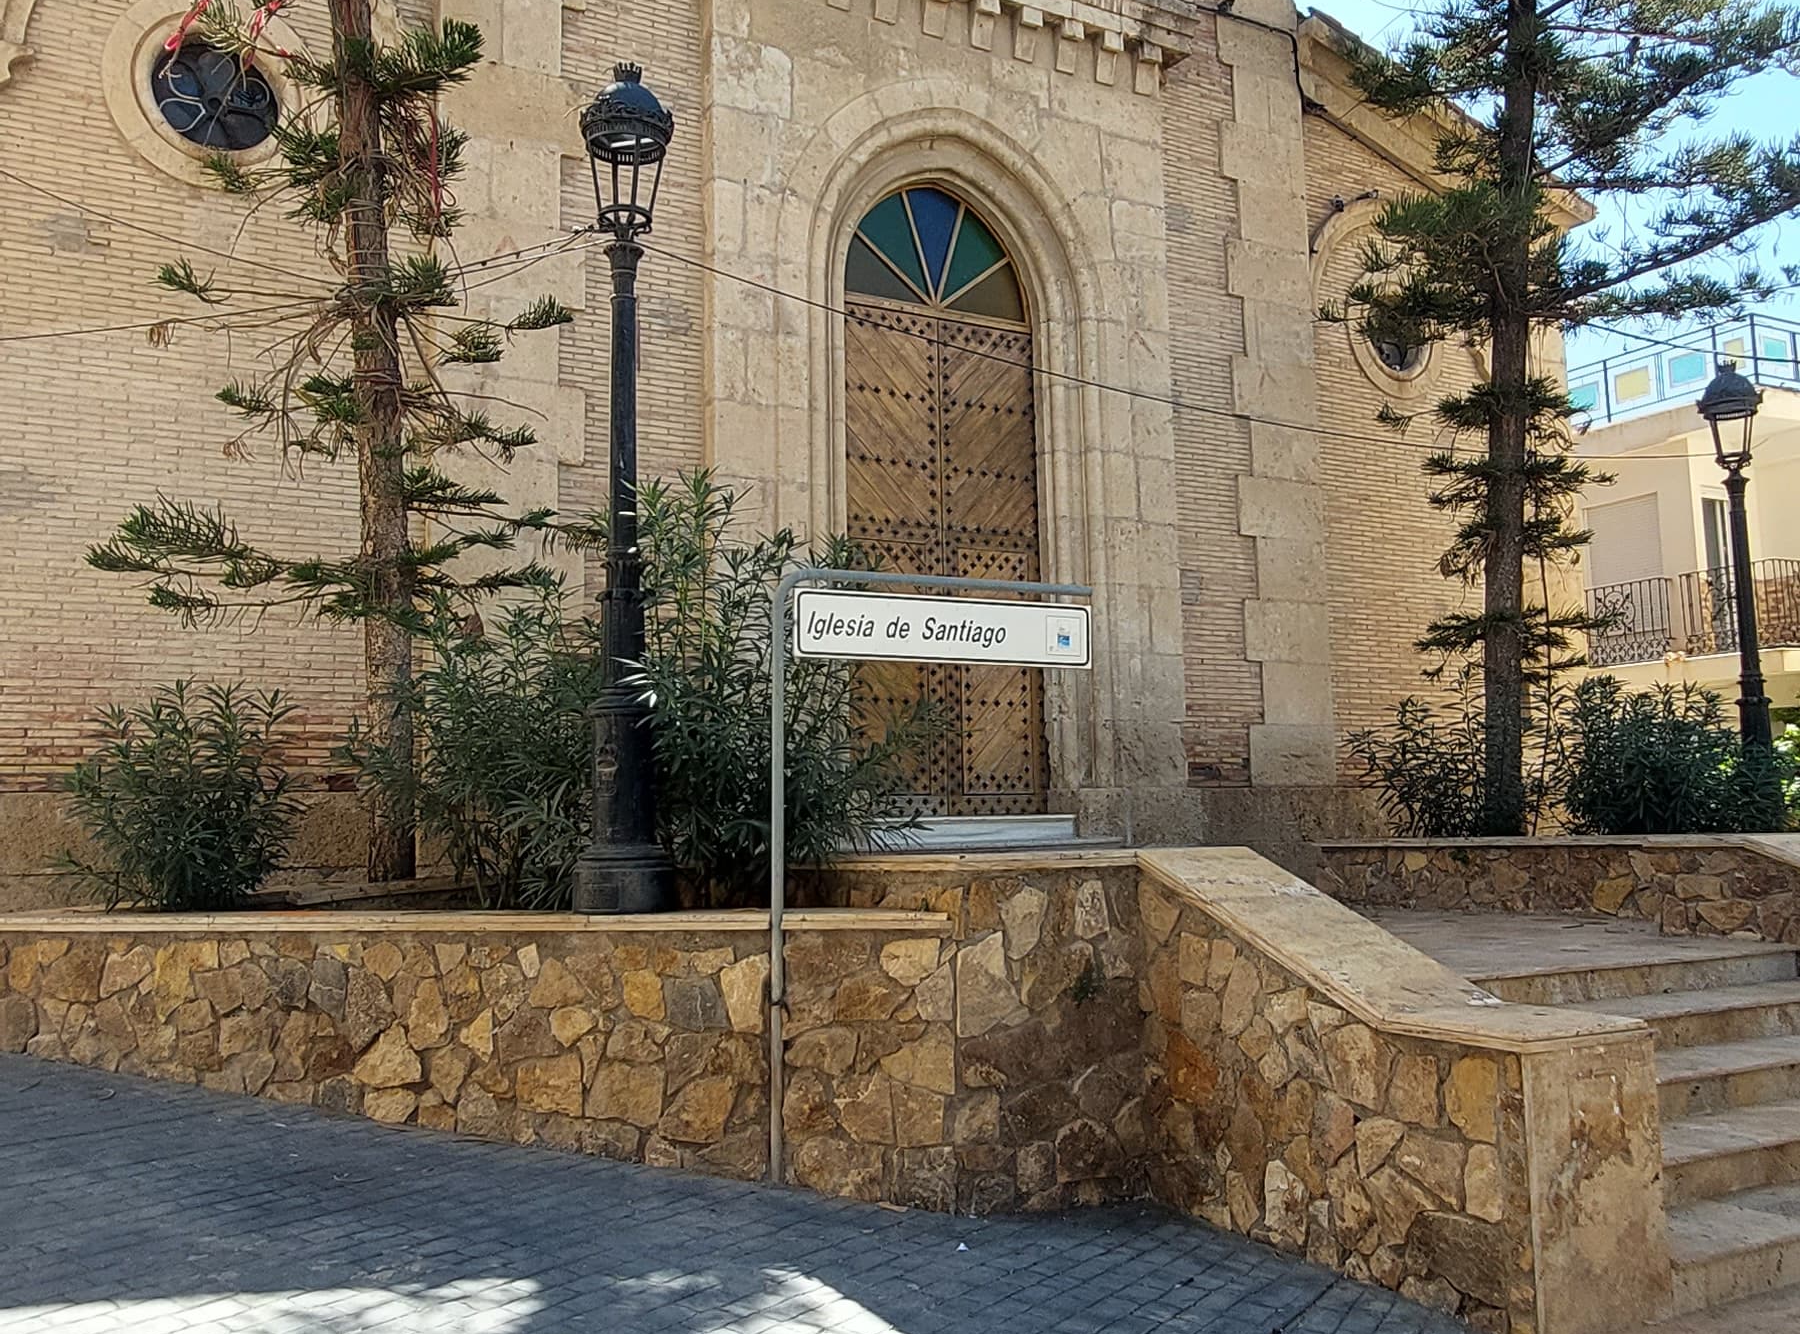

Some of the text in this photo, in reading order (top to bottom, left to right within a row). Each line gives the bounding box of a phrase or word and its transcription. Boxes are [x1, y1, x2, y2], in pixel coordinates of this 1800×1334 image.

[807, 610, 1006, 648] Iglesia de Santiago
